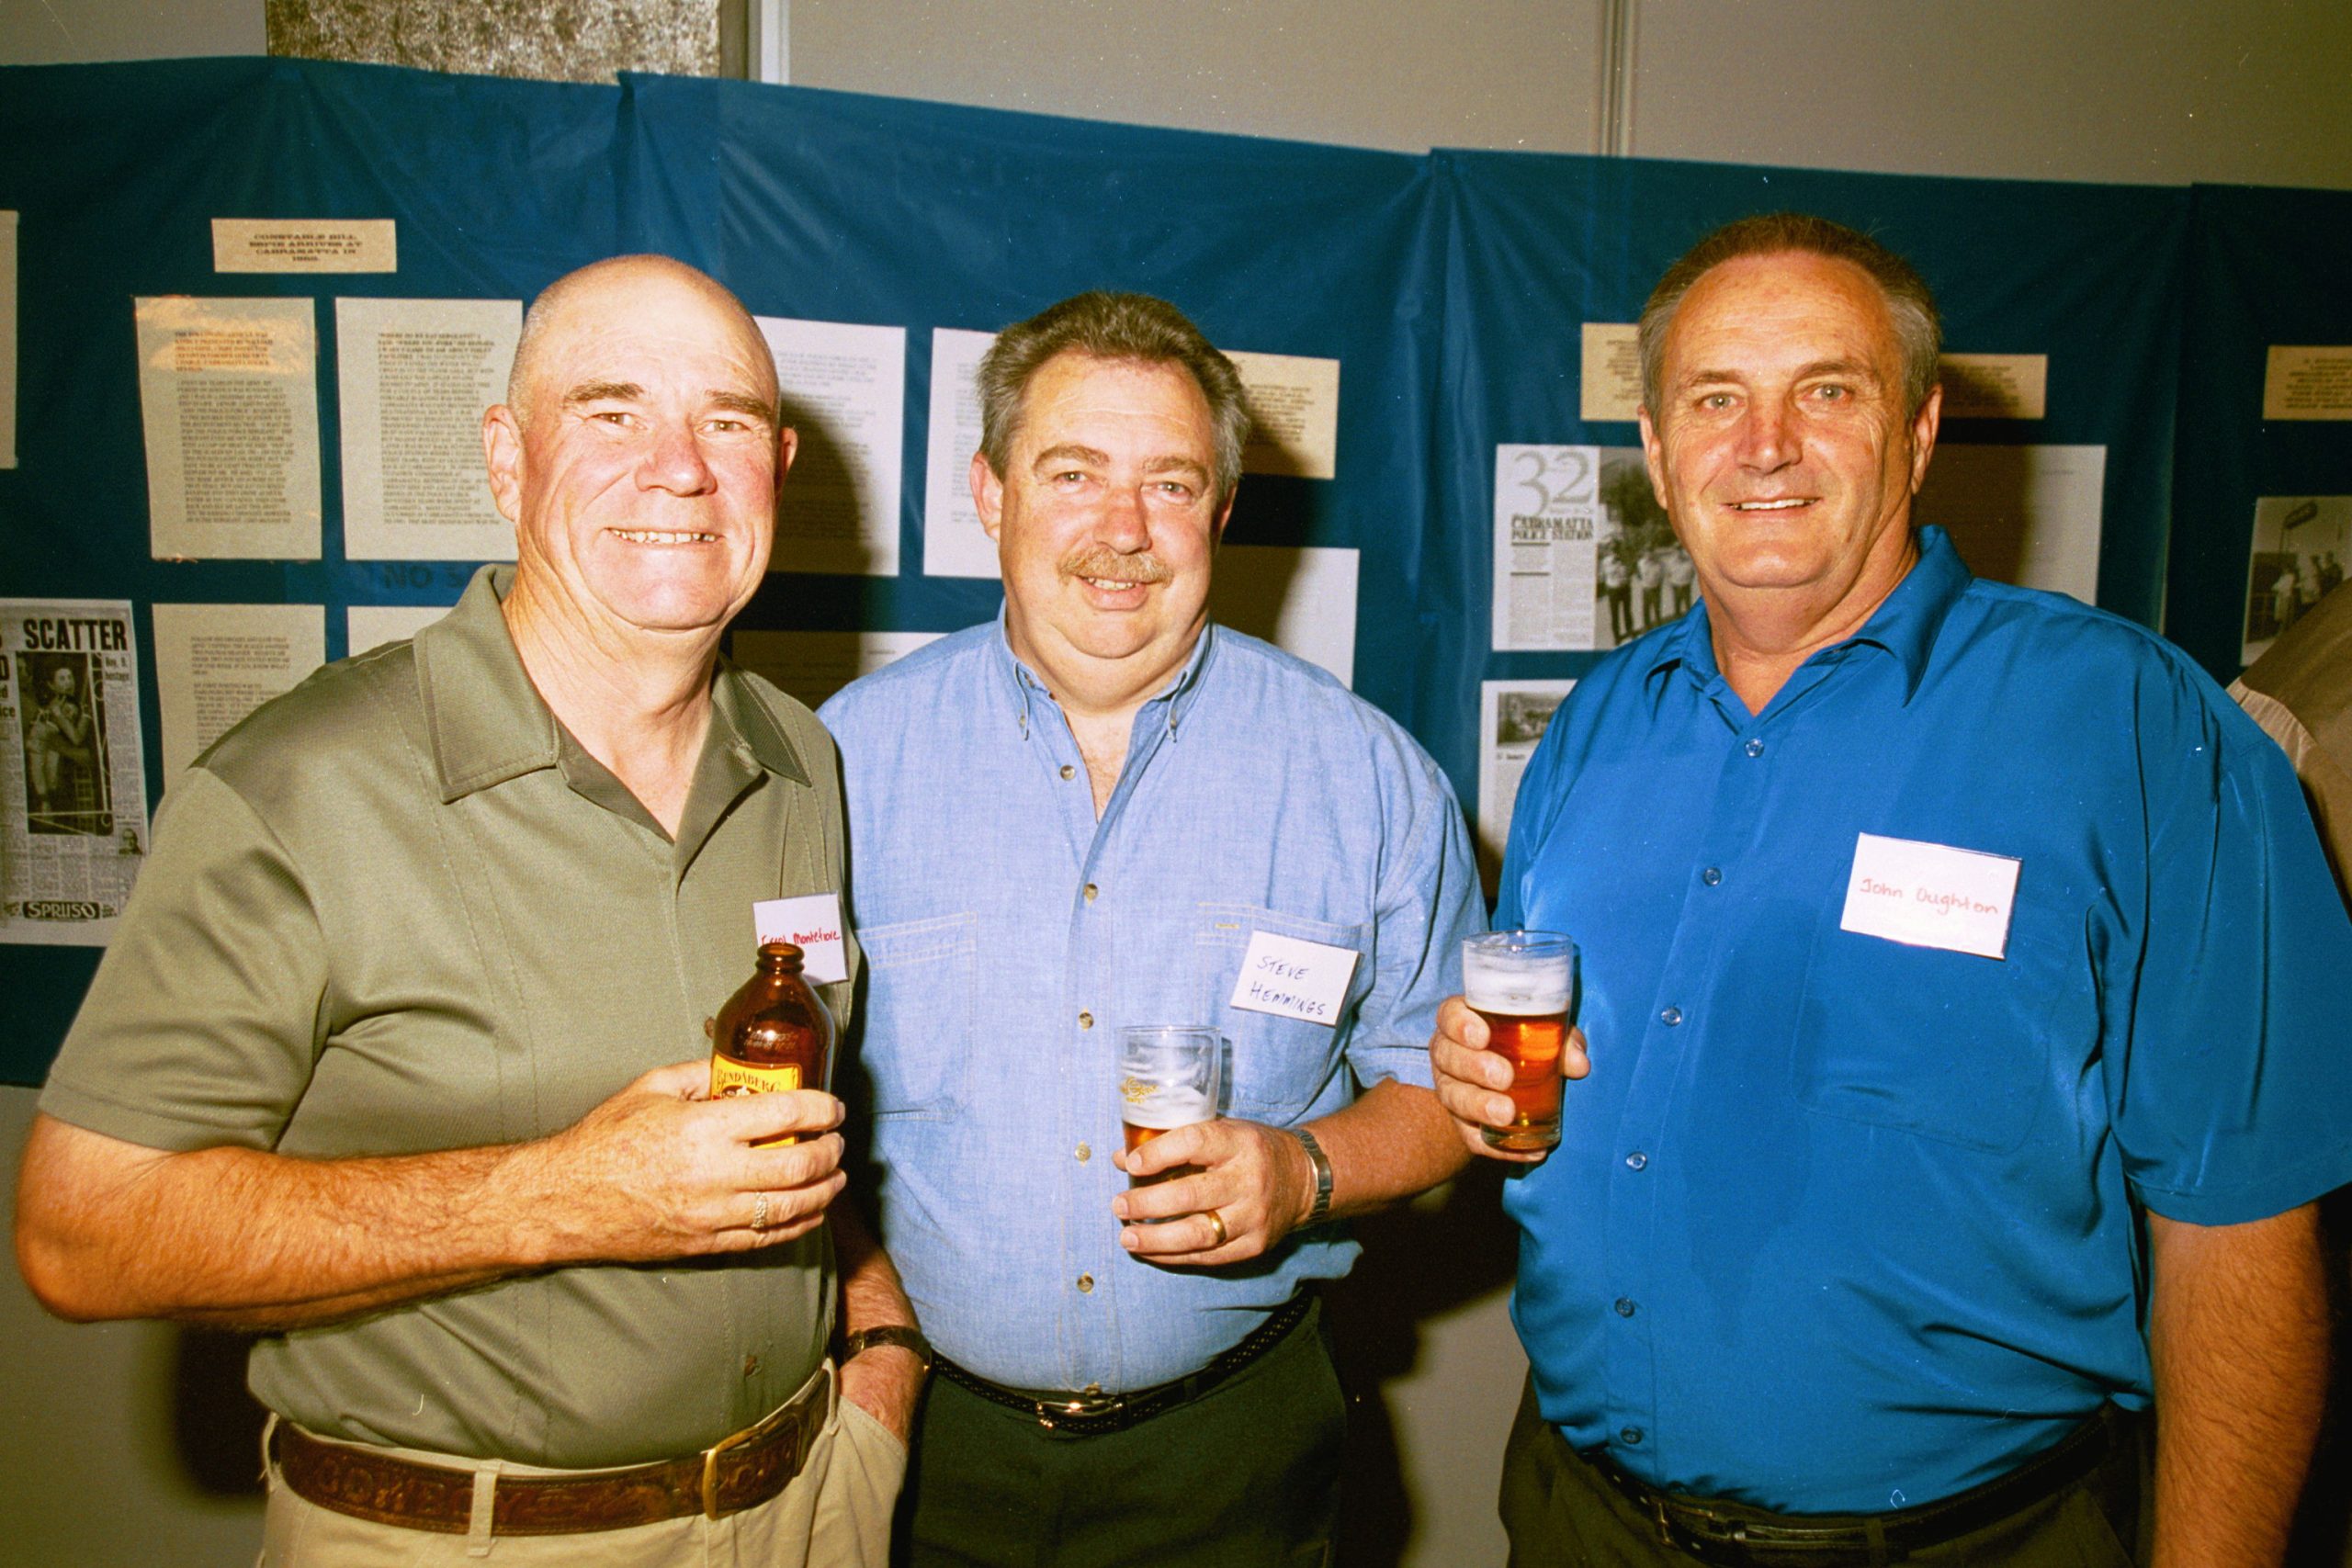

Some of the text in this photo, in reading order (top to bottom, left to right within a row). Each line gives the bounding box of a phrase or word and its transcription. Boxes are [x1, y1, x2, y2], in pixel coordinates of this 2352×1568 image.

[1514, 450, 1594, 516] 32
[22, 617, 129, 651] SCATTER
[1859, 878, 1904, 898] John
[1257, 955, 1311, 980] STEVE
[1250, 980, 1327, 1016] HEMMINGS
